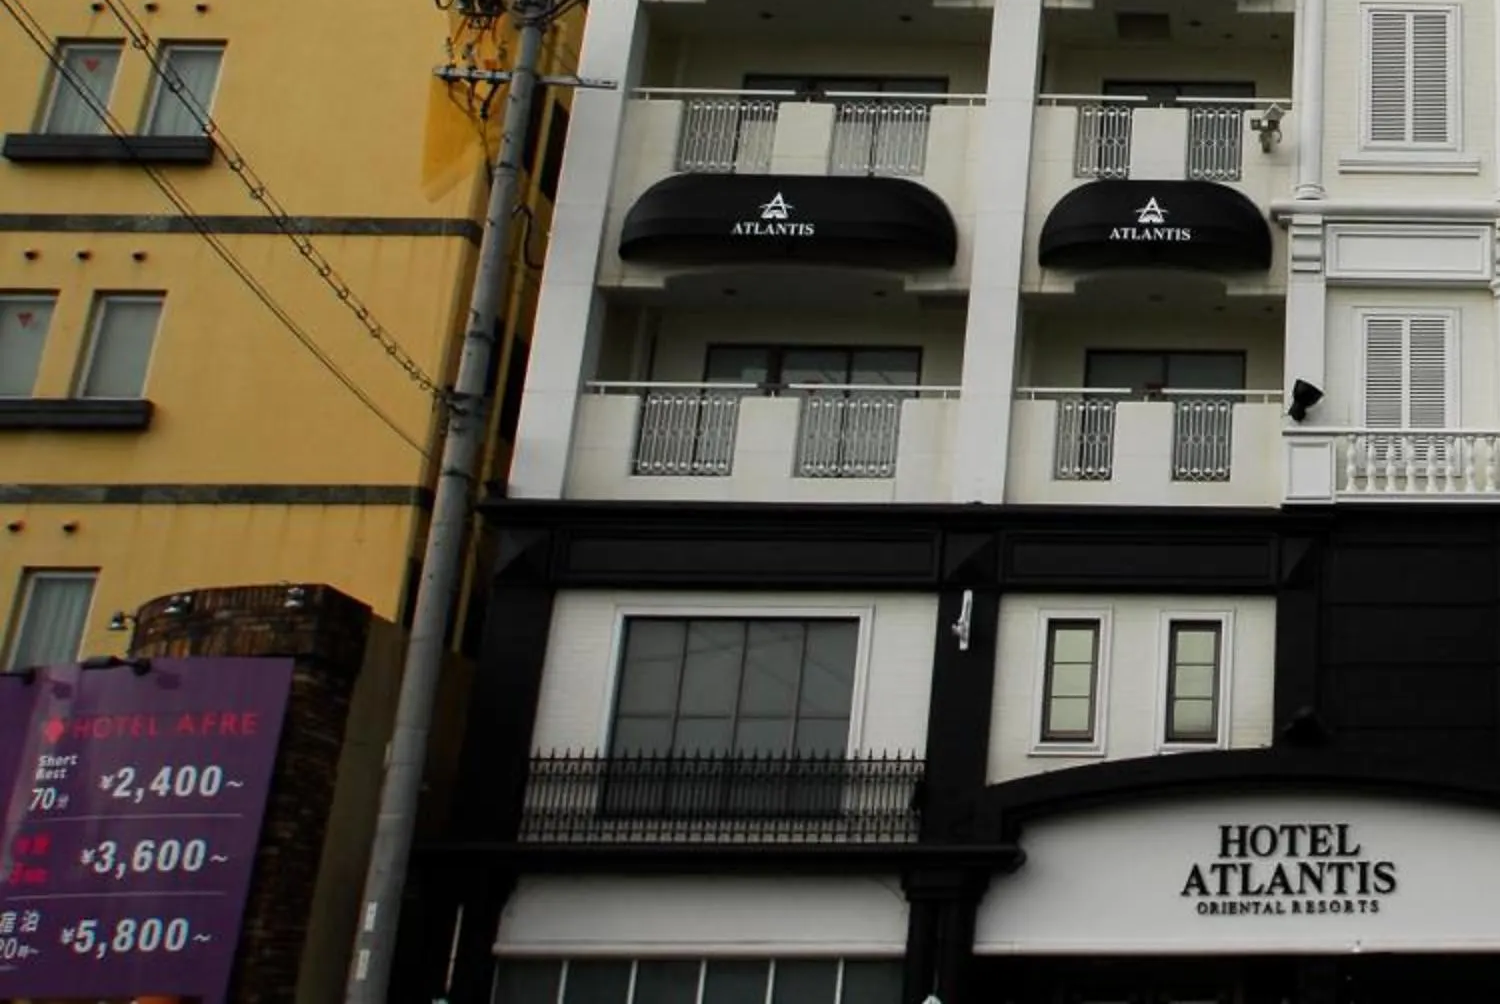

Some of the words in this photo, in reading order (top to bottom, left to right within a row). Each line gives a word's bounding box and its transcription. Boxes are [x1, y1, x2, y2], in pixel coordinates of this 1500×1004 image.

[732, 222, 815, 236] ATLANTIS
[1109, 227, 1191, 241] ATLANTIS
[72, 714, 159, 739] HOTEL
[176, 712, 260, 736] AFRE
[1218, 823, 1361, 858] HOTEL
[1180, 861, 1397, 896] ATLANTIS
[1196, 901, 1286, 915] ORIENTAL
[1292, 900, 1380, 914] RESORTS
